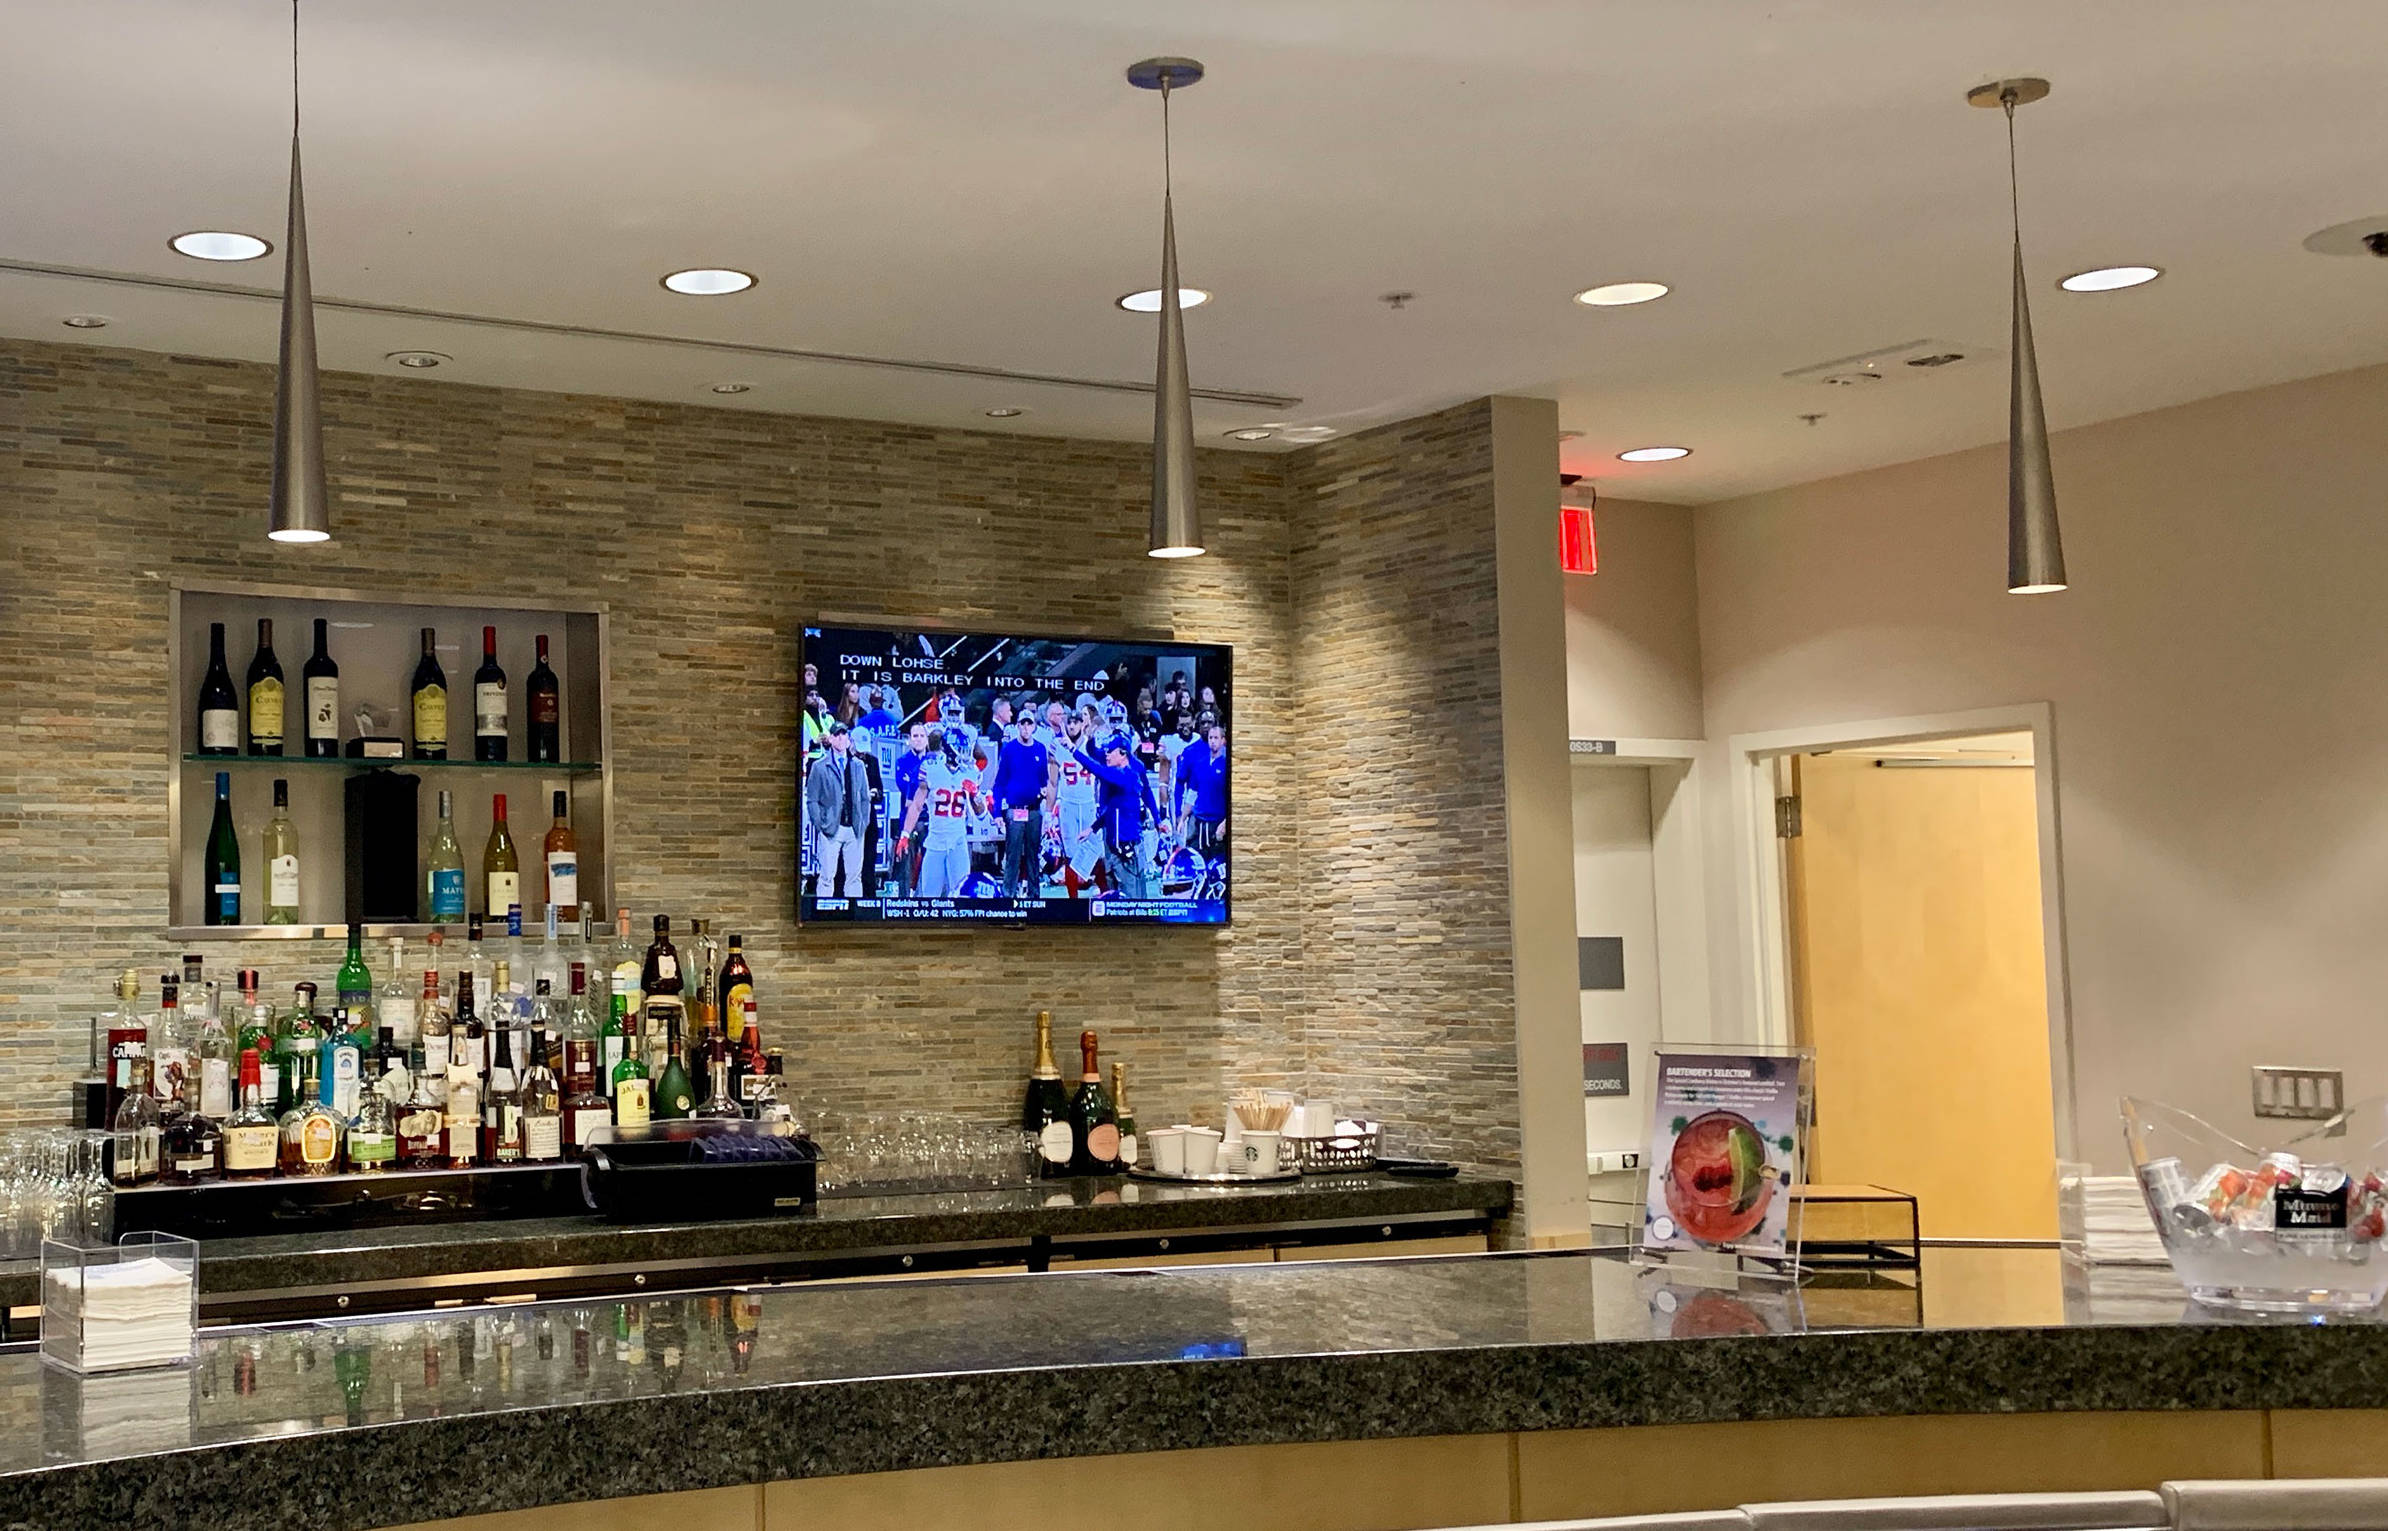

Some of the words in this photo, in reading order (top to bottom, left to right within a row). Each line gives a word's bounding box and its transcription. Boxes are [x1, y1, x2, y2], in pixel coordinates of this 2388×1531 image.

[840, 654, 882, 666] DOWN
[892, 657, 944, 669] LOHSE
[842, 669, 860, 680] IT
[874, 671, 892, 681] IS
[902, 672, 973, 685] BARKLEY
[987, 676, 1025, 687] INTO
[1035, 678, 1064, 689] THE
[1074, 680, 1105, 691] END
[935, 788, 966, 817] 26
[816, 899, 849, 910] ESPN
[886, 899, 919, 908] Redskins
[931, 899, 955, 907] Giants
[1714, 1068, 1751, 1078] SELECTION
[2283, 1200, 2340, 1211] Minute
[2290, 1211, 2332, 1224] Maid
